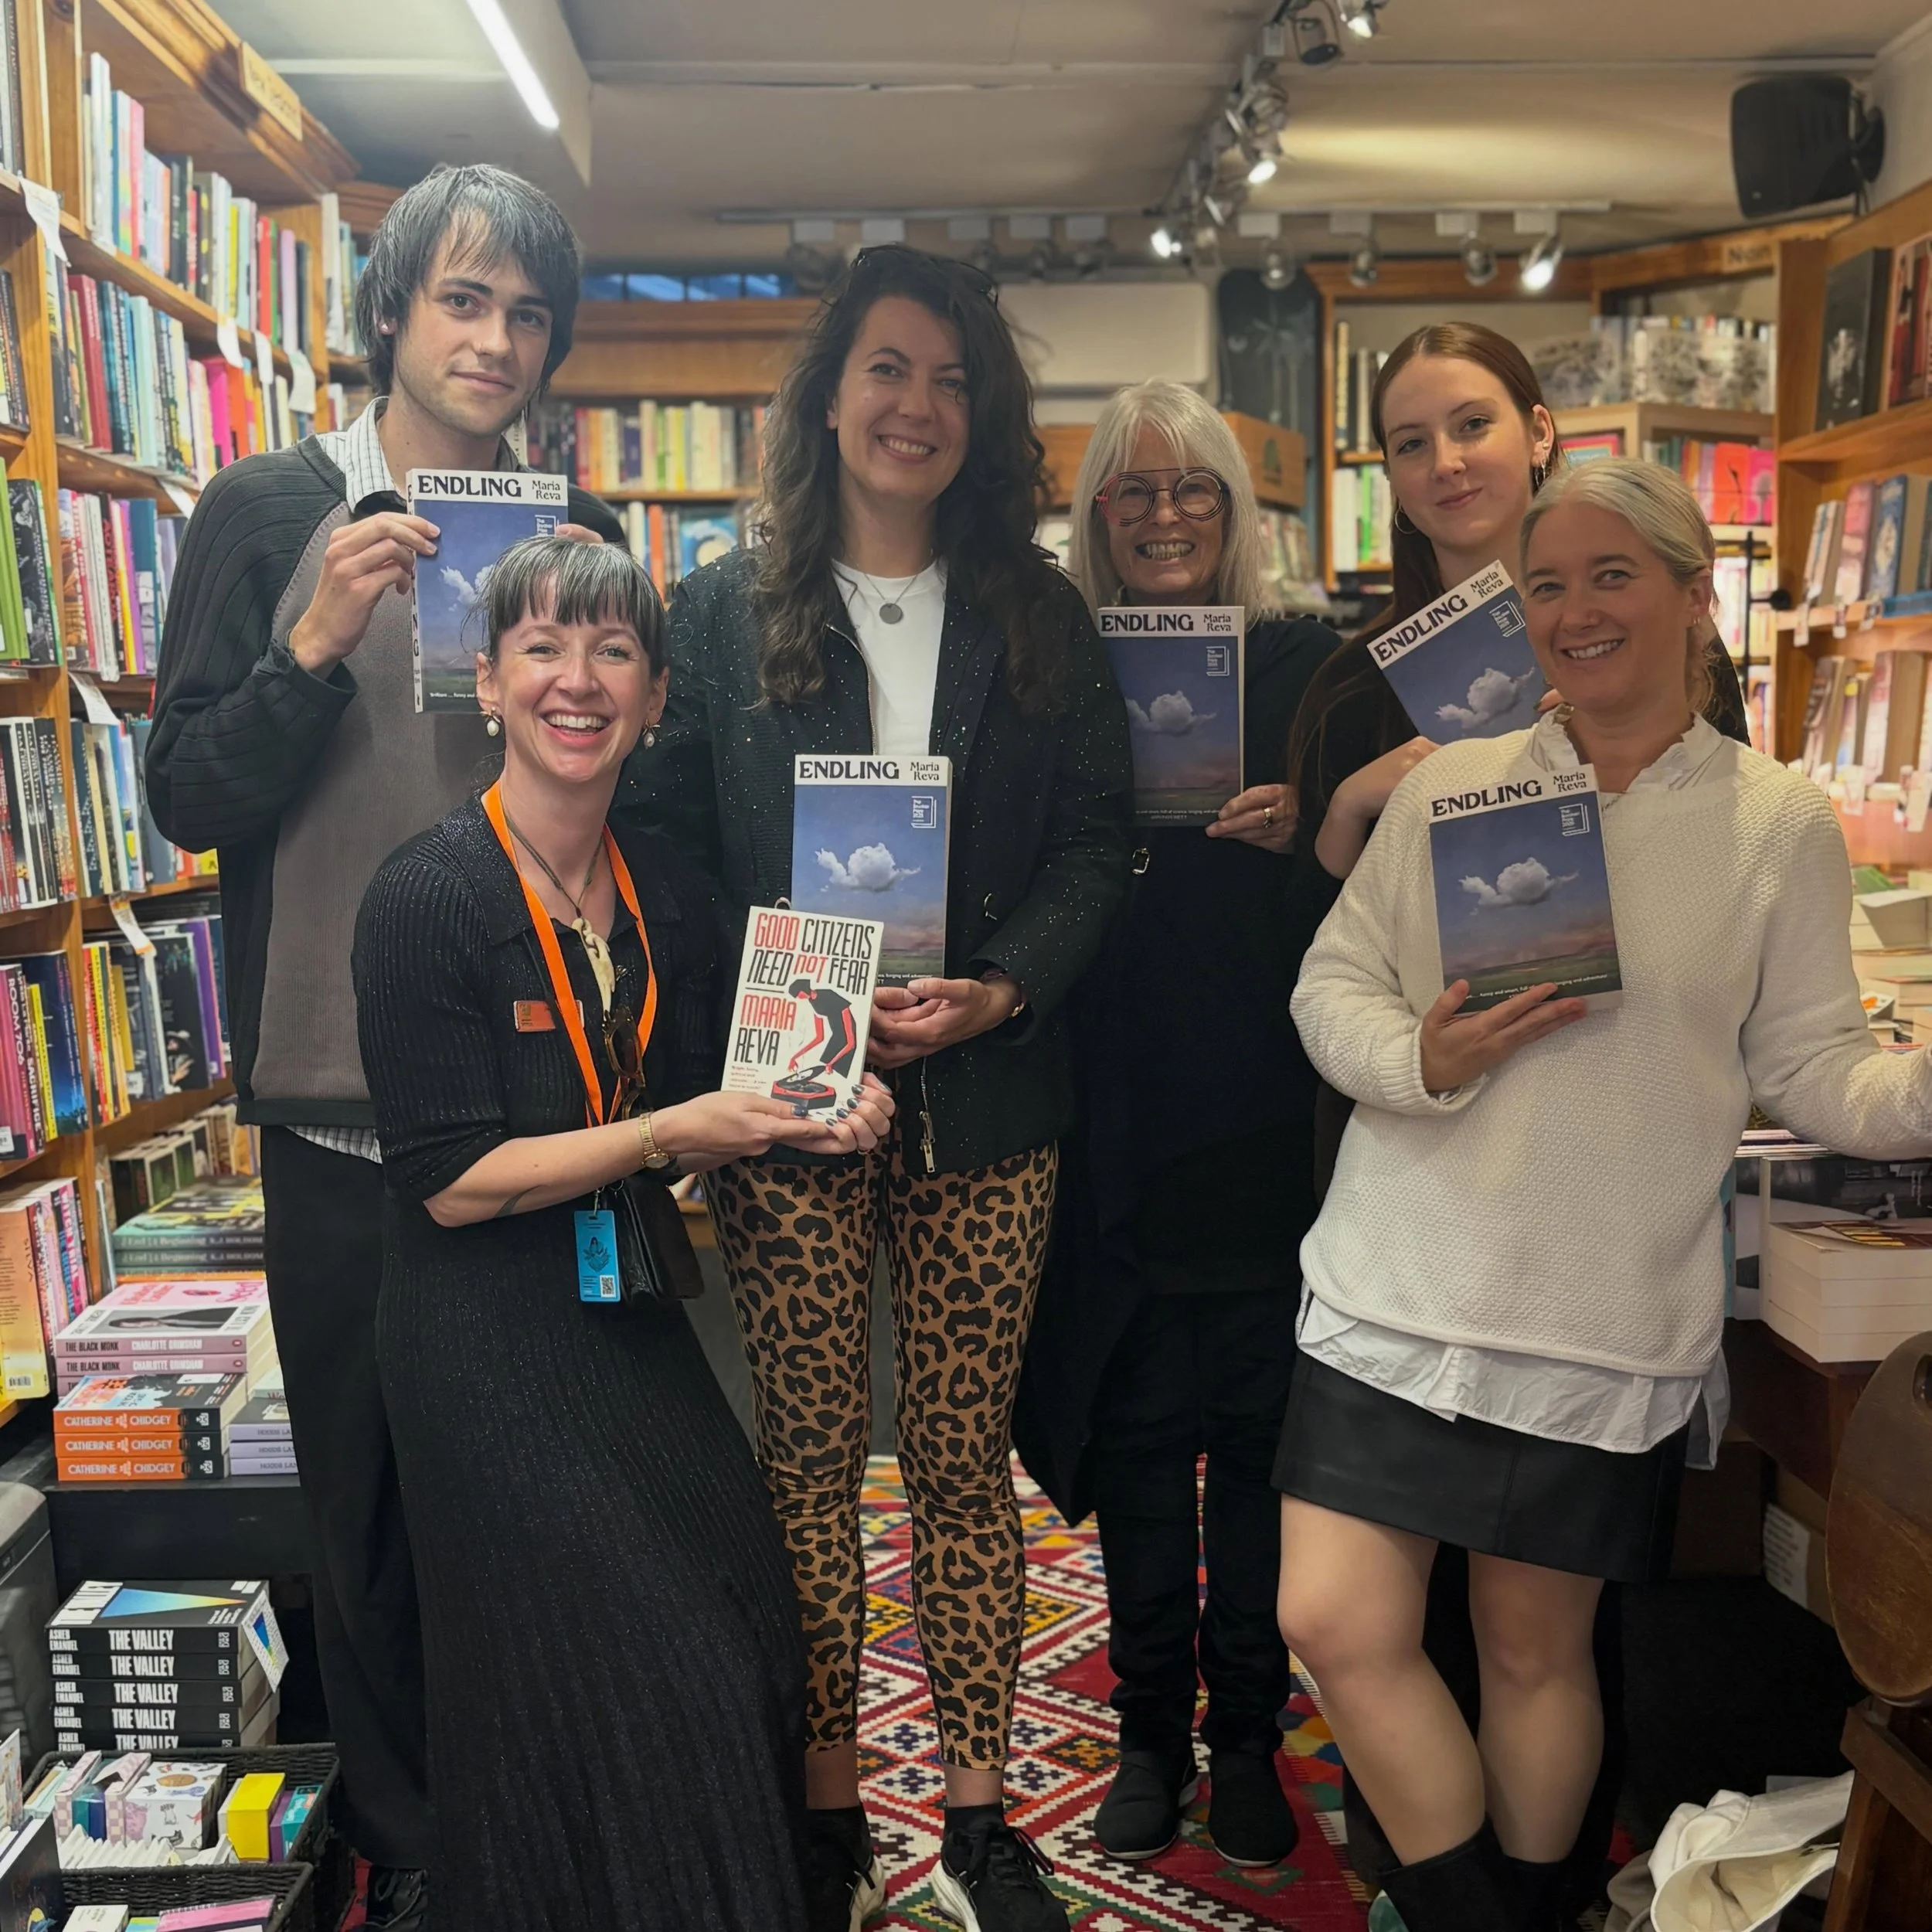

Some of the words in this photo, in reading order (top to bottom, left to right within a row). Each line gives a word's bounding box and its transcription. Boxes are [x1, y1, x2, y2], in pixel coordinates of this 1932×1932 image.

[418, 474, 522, 498] ENDLING
[532, 479, 561, 492] Maria
[536, 490, 561, 501] Reva
[1470, 570, 1499, 593] Maria
[1478, 579, 1504, 598] Reva
[1100, 614, 1194, 632] ENDLING
[1203, 614, 1231, 623] Maria
[1206, 623, 1231, 632] Reva
[1373, 594, 1468, 662] ENDLING
[799, 760, 900, 780] ENDLING
[910, 762, 939, 772] Maria
[913, 771, 939, 781] Reva
[1553, 772, 1586, 784] Maria
[1557, 781, 1587, 793] Reva
[1431, 780, 1543, 817] ENDLING
[754, 913, 800, 951] GOOD
[801, 918, 875, 960] CITIZENS
[747, 949, 794, 986] NEED
[793, 954, 828, 983] NOT
[828, 958, 870, 995] FEAR
[740, 994, 797, 1031] MARIA
[8, 978, 21, 1031] ROOM
[15, 1032, 25, 1066] 706
[733, 1028, 781, 1066] REVA
[27, 1057, 41, 1131] SACRIFICE
[61, 1192, 73, 1236] WITCH
[67, 1241, 80, 1278] TRIAL
[65, 1342, 77, 1352] THE
[79, 1342, 98, 1352] BLACK
[100, 1341, 119, 1351] MONK
[131, 1340, 167, 1351] CHARLOTTE
[168, 1339, 202, 1350] GRIMSHAW
[66, 1362, 78, 1372] THE
[80, 1362, 100, 1372] BLACK
[101, 1362, 121, 1371] MONK
[133, 1360, 168, 1371] CHARLOTTE
[170, 1359, 203, 1370] GRIMSHAW
[64, 1416, 113, 1426] CATHERINE
[130, 1415, 171, 1425] CHIDGEY
[65, 1440, 115, 1451] CATHERINE
[131, 1440, 172, 1450] CHIDGEY
[68, 1464, 117, 1474] CATHERINE
[134, 1463, 175, 1473] CHIDGEY
[49, 1629, 70, 1640] ASHER
[109, 1630, 131, 1651] THE
[132, 1630, 174, 1651] VALLEY
[49, 1640, 78, 1651] EMANUEL
[53, 1655, 73, 1664] ASHER
[111, 1656, 133, 1676] THE
[134, 1656, 175, 1676] VALLEY
[53, 1665, 80, 1675] EMANUEL
[56, 1682, 77, 1692] ASHER
[114, 1683, 136, 1703] THE
[137, 1683, 179, 1704] VALLEY
[56, 1692, 84, 1703] EMANUEL
[54, 1706, 74, 1716] ASHER
[54, 1717, 83, 1728] EMANUEL
[112, 1709, 134, 1729] THE
[135, 1709, 175, 1730] VALLEY
[115, 1735, 138, 1750] THE
[138, 1735, 179, 1750] VALLEY
